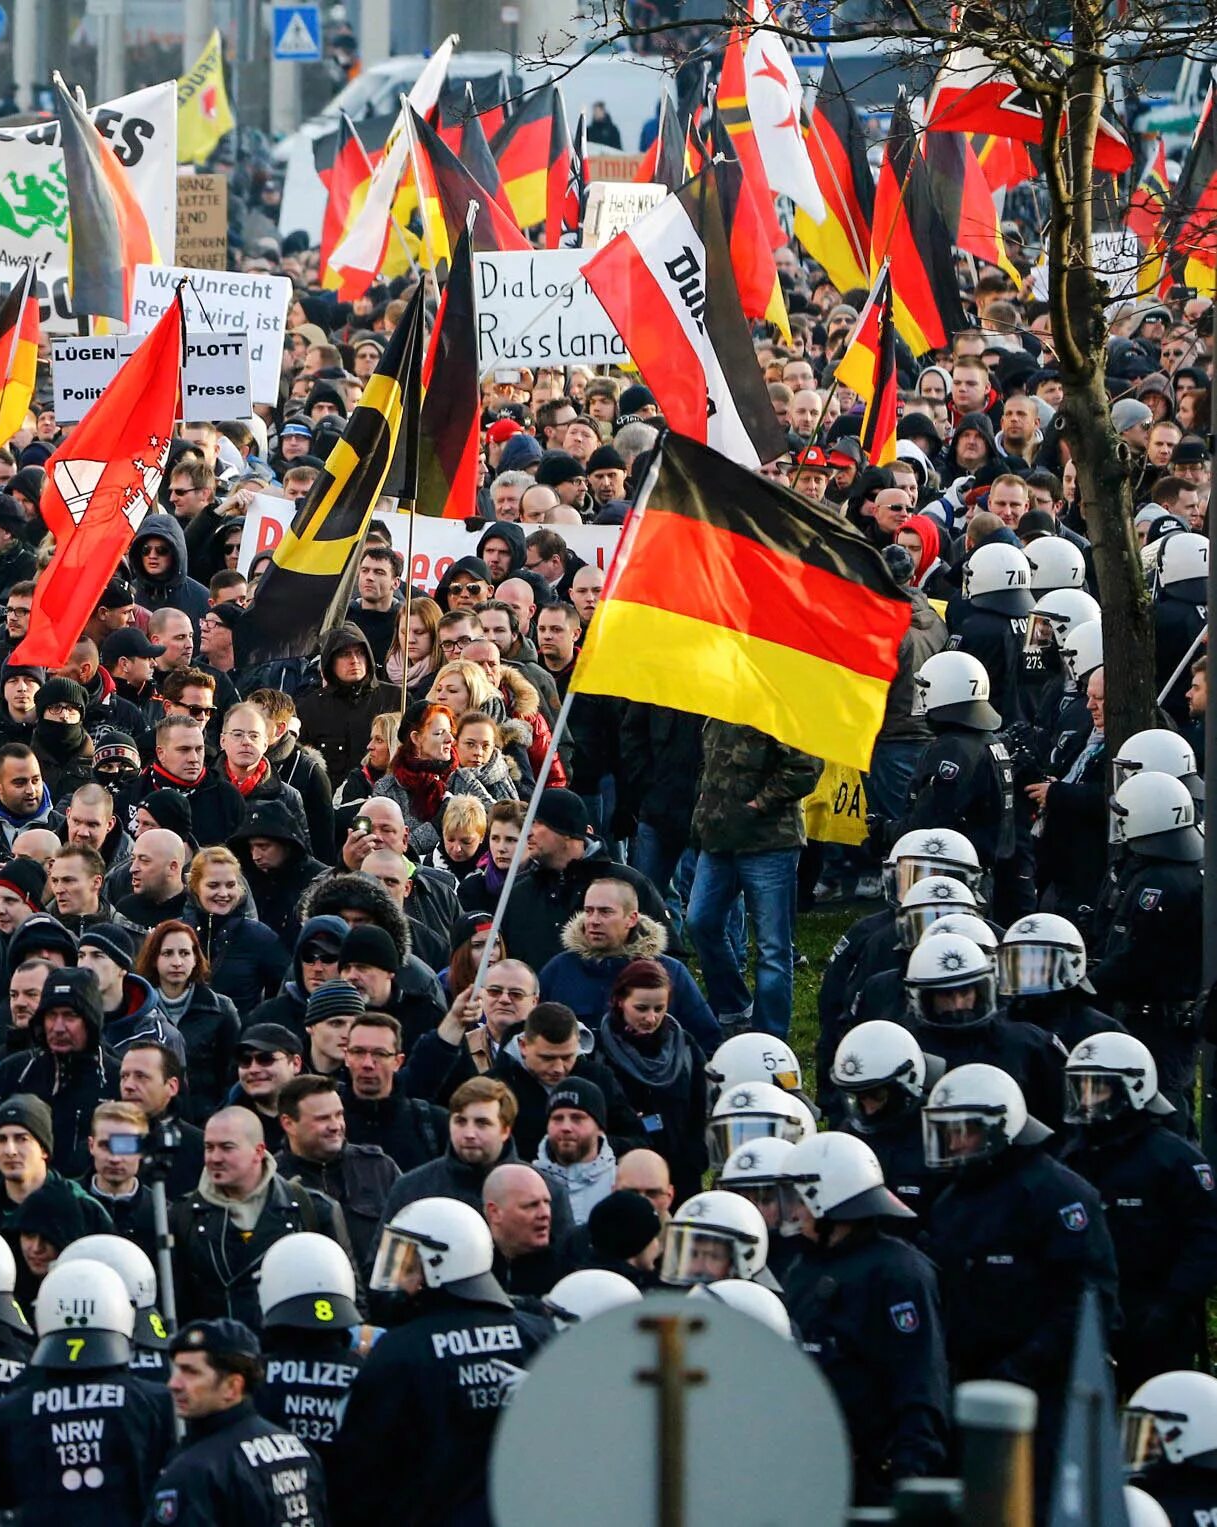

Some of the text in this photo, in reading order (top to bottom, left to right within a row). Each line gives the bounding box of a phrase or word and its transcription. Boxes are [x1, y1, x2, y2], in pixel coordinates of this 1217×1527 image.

[191, 275, 272, 299] Unrecht
[479, 260, 574, 308] Dialog
[200, 307, 250, 331] wird,
[255, 312, 280, 332] ist
[478, 312, 627, 361] Russland
[54, 346, 116, 362] LÜGEN
[187, 384, 246, 396] Presse
[1025, 656, 1047, 670] 273
[314, 1299, 335, 1322] 8
[149, 1313, 168, 1339] 8
[66, 1338, 85, 1361] 7
[431, 1325, 523, 1359] POLIZEI
[32, 1383, 126, 1416] POLIZEI
[285, 1394, 336, 1418] NRW
[51, 1418, 105, 1444] NRW
[288, 1418, 335, 1443] 1332
[56, 1441, 102, 1466] 1331
